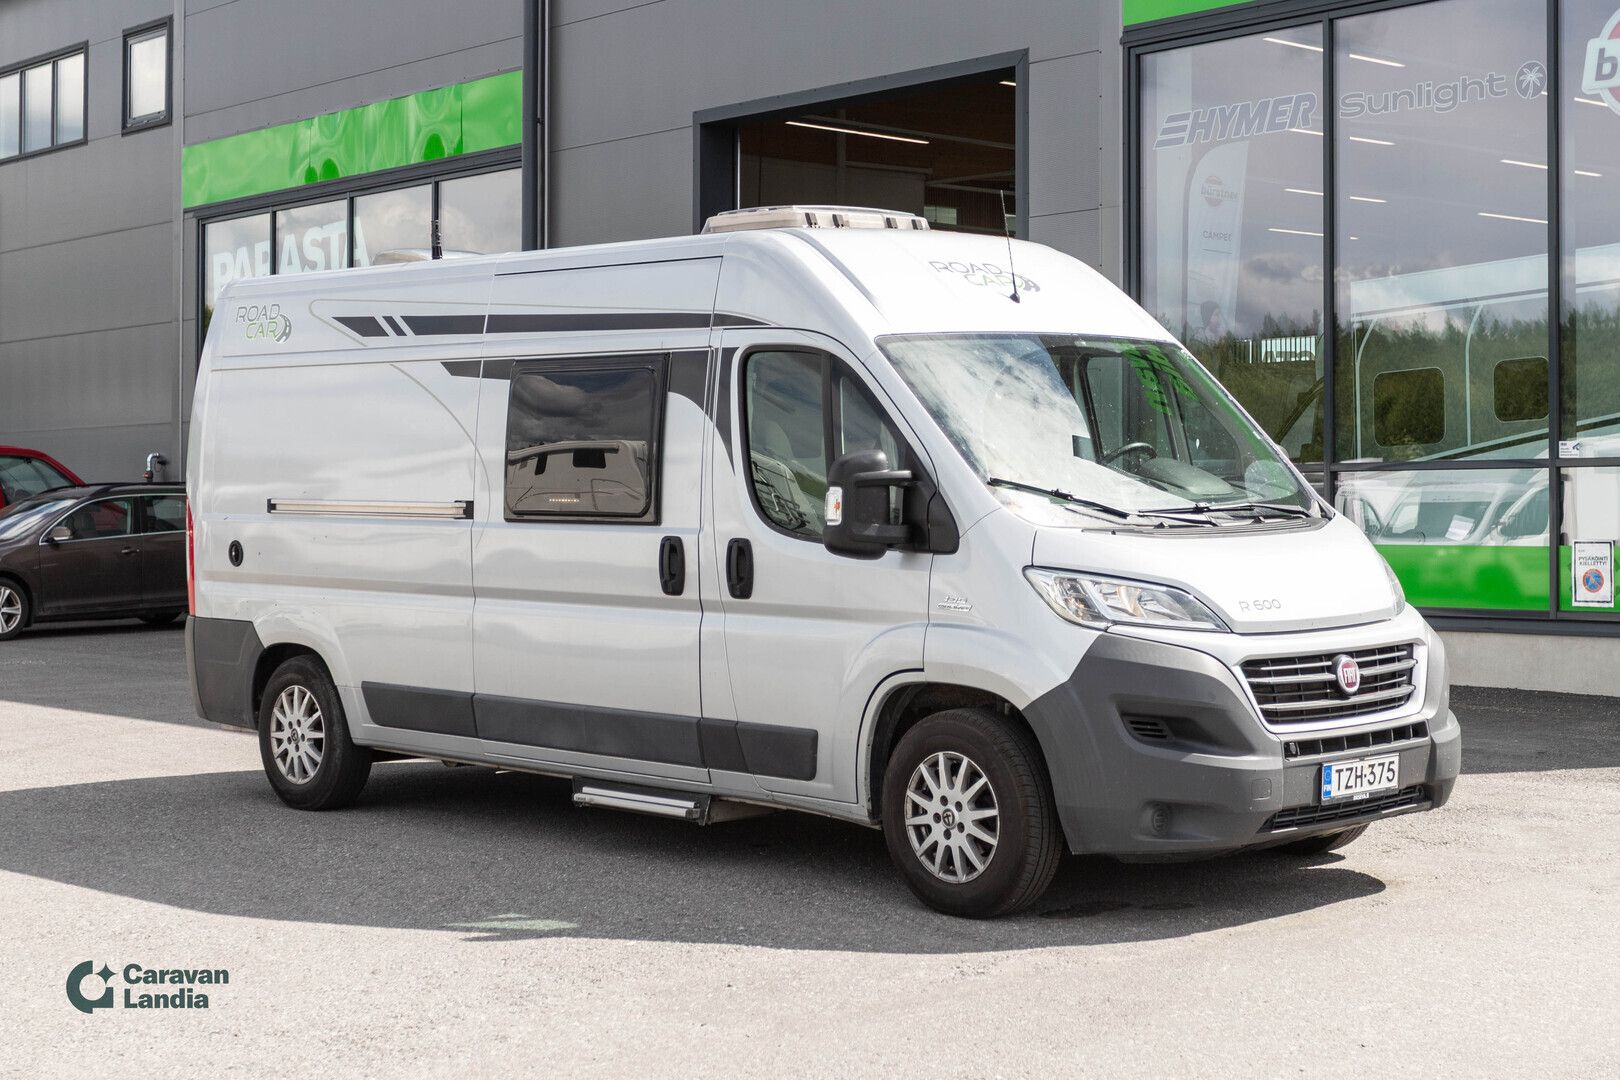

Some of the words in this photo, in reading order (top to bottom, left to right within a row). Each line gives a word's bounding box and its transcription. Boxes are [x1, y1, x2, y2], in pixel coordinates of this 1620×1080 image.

[1339, 72, 1508, 119] Sunlight
[1184, 91, 1318, 145] HYMER
[928, 260, 1003, 275] ROAD
[235, 303, 281, 323] ROAD
[246, 321, 278, 339] CAR
[1238, 600, 1250, 612] R
[1253, 598, 1282, 611] 600
[1343, 667, 1357, 685] FIAT
[1335, 760, 1396, 792] TZH-375
